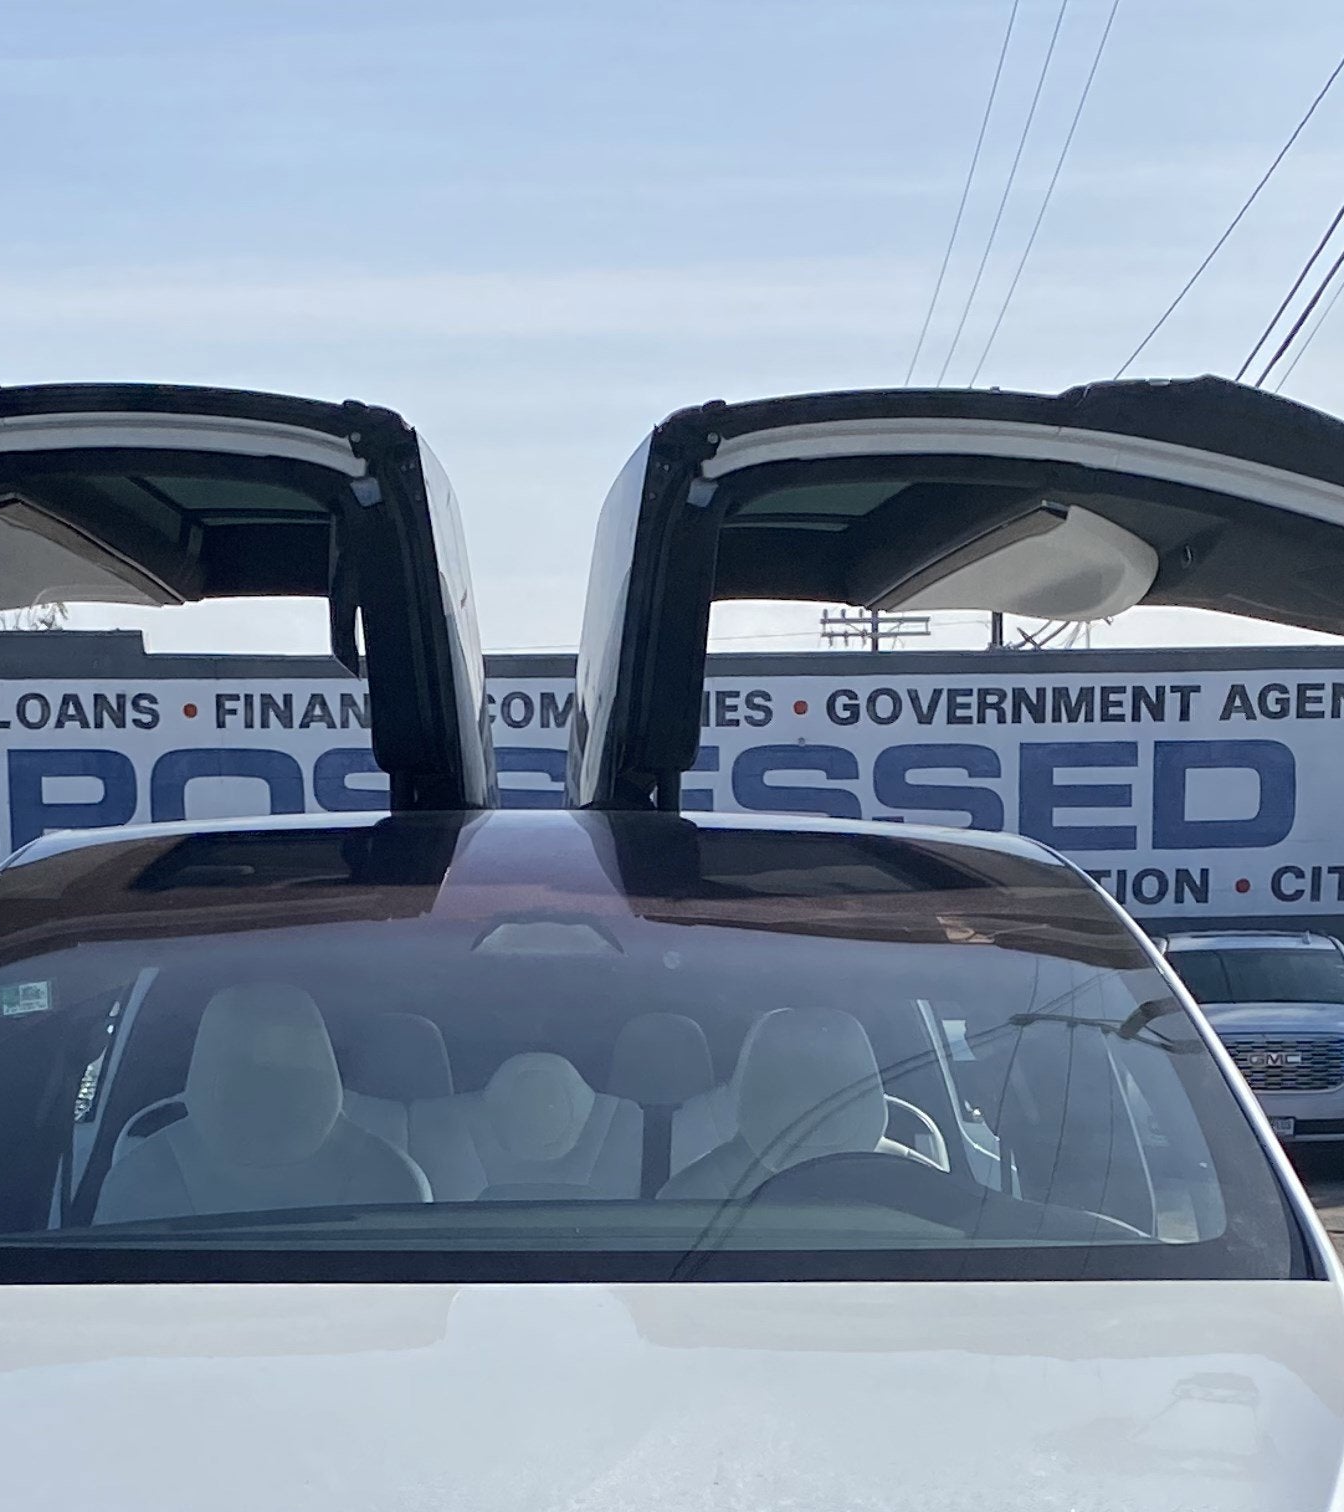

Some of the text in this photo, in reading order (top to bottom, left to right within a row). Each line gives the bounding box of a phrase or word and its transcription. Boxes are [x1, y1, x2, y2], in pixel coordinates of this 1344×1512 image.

[215, 692, 372, 730] FINAN
[826, 684, 1201, 726] GOVERNMENT
[1246, 1053, 1302, 1066] GMC
